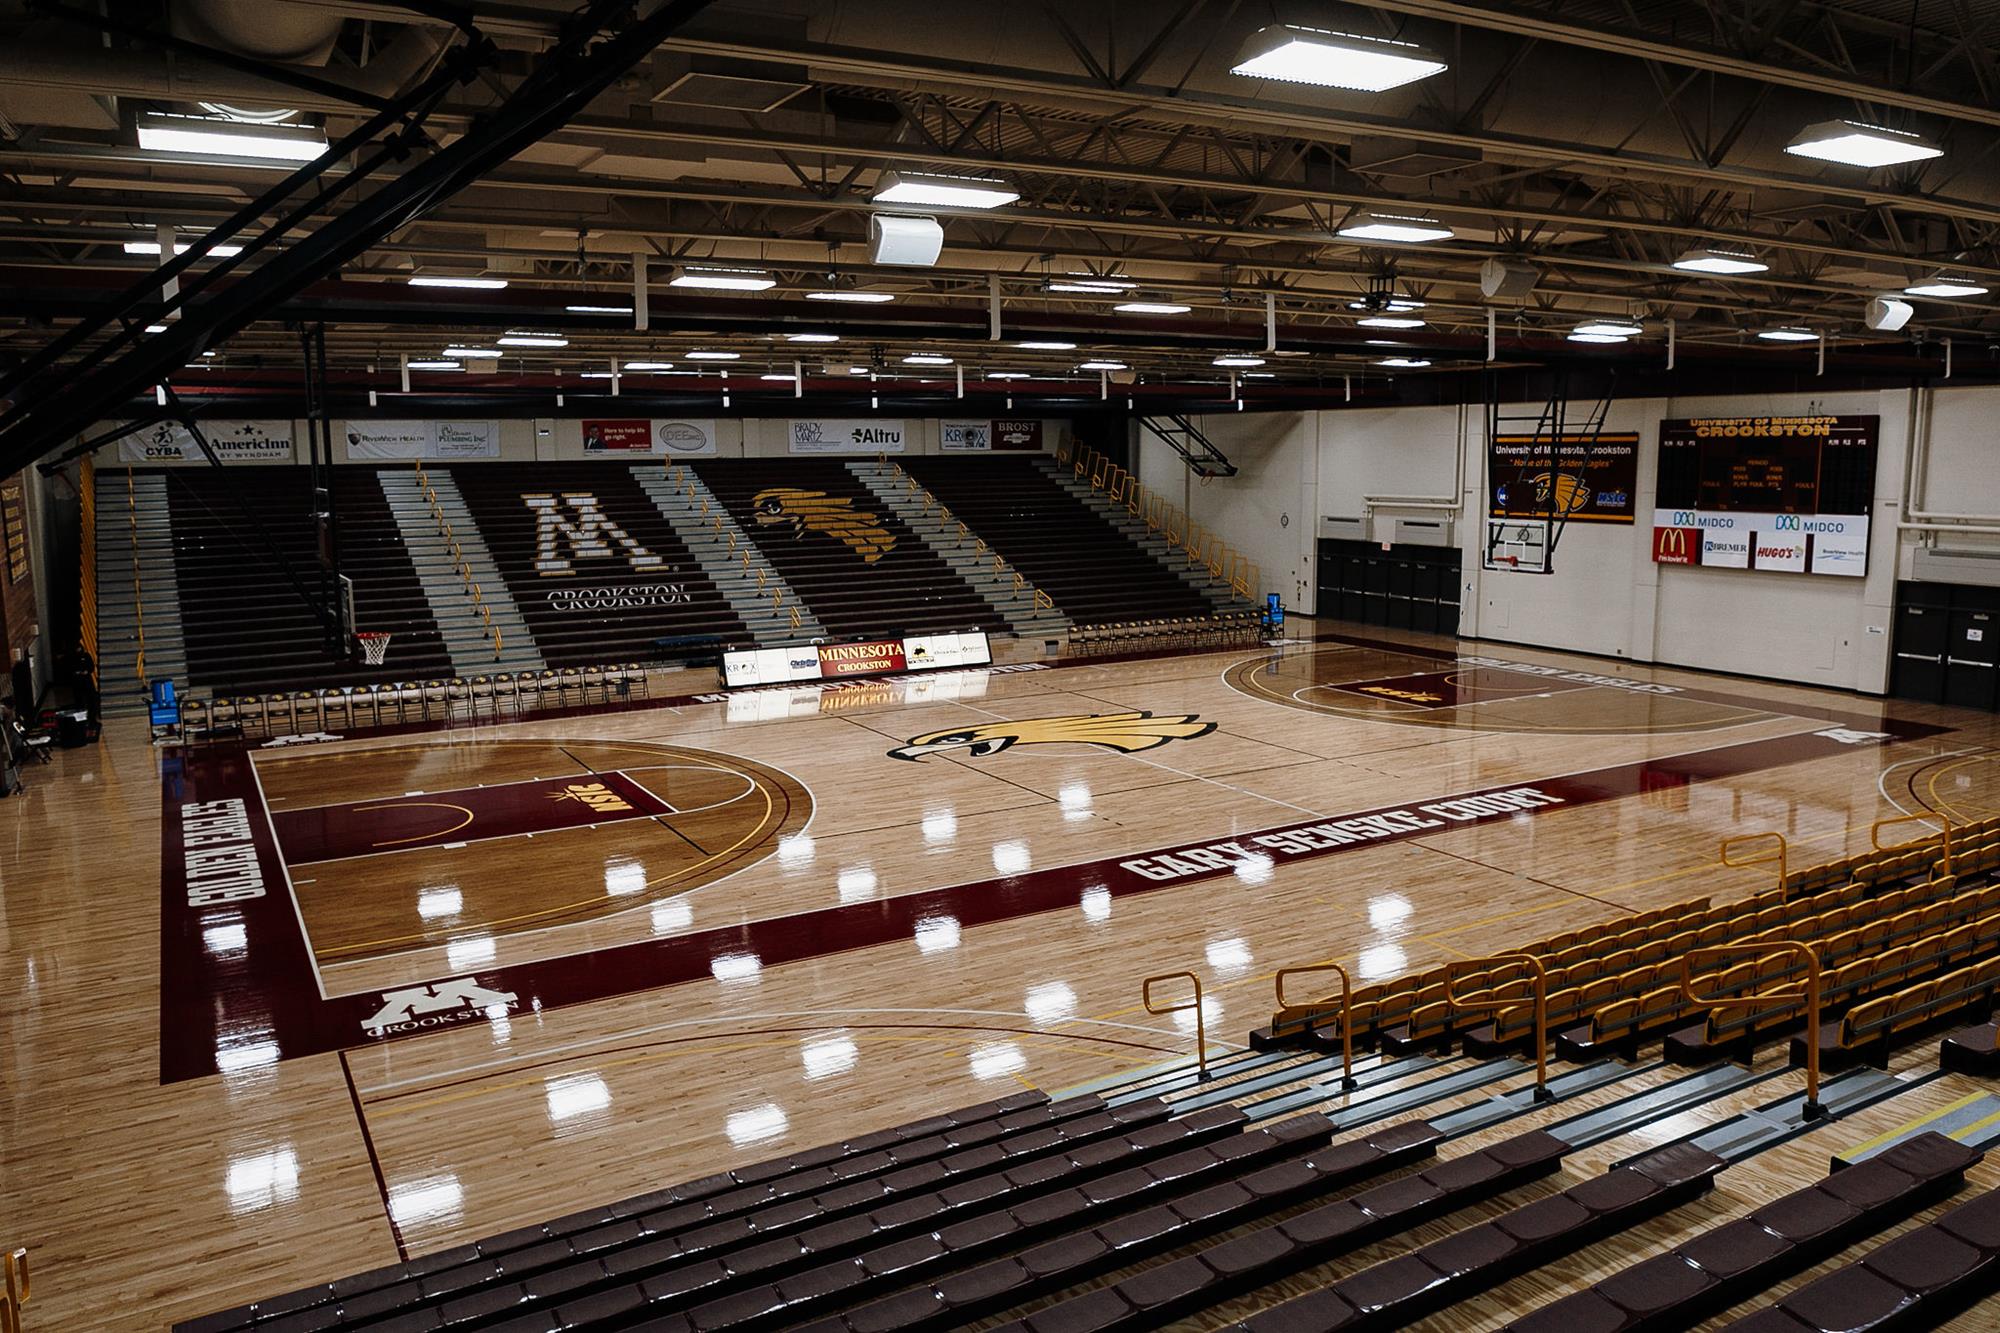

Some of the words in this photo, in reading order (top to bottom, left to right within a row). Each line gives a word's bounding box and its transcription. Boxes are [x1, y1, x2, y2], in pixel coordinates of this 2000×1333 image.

[794, 422, 822, 432] BRADY
[998, 422, 1035, 432] BROST
[1690, 418, 1751, 427] UNIVERSITY
[1771, 416, 1838, 425] MINNESOTA
[862, 428, 900, 443] Altru
[1696, 424, 1831, 437] CROOKSTON
[211, 438, 290, 450] AmericInn
[1534, 445, 1543, 455] of
[1590, 445, 1631, 455] rookston
[146, 447, 182, 456] CYBA
[1698, 518, 1734, 528] MIDCO
[1804, 522, 1844, 533] MIDCO
[1713, 543, 1747, 553] BREMER
[1757, 546, 1794, 559] HUGO'S
[547, 583, 692, 611] CROOKSTON
[819, 643, 905, 662] MINNESOTA
[836, 659, 892, 673] CROOKSTON
[1455, 656, 1563, 676] GOLDEN
[1563, 672, 1686, 694] EAGLES
[181, 798, 253, 847] EAGLES
[1252, 810, 1446, 855] SENSKE
[1430, 787, 1566, 821] COURT
[185, 843, 267, 907] GOLDEN
[366, 1000, 520, 1038] CROOKSTN
